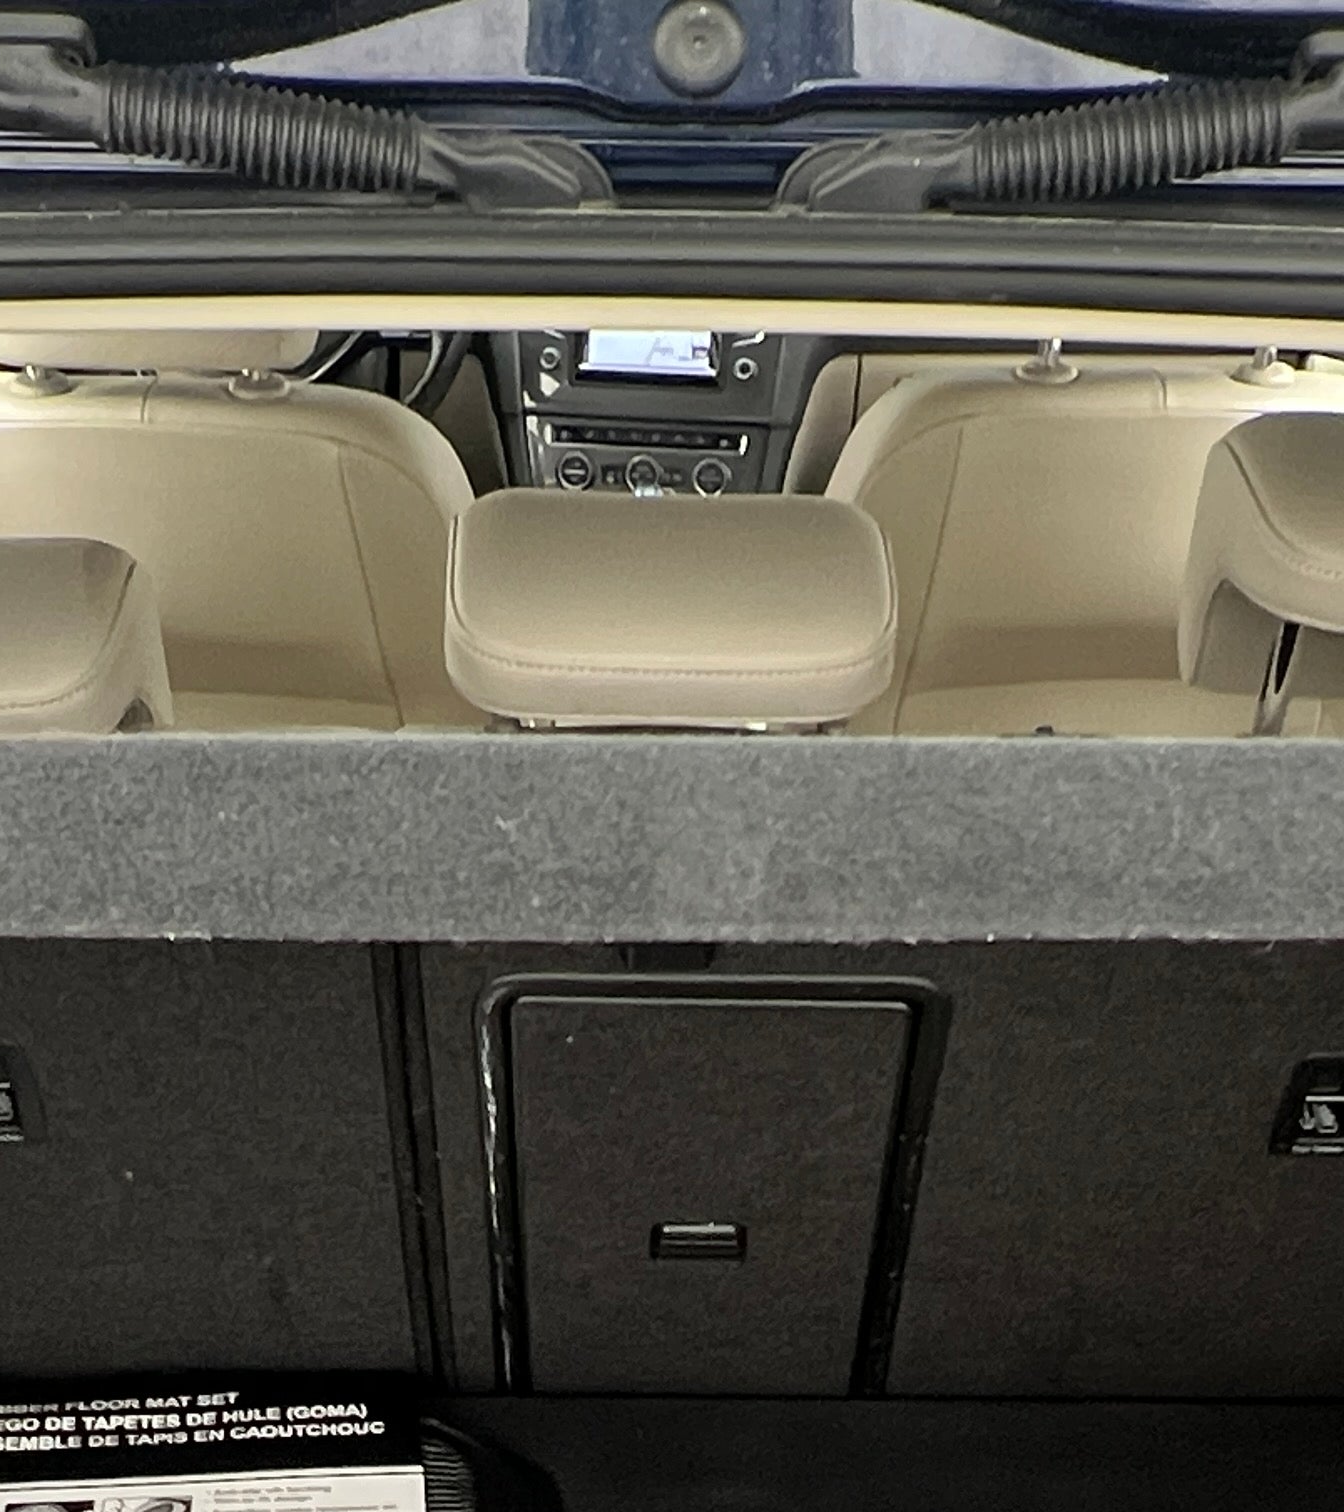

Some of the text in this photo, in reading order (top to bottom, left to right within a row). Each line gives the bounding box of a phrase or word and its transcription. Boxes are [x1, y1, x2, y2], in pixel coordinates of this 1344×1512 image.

[65, 1398, 141, 1411] FLOOR
[145, 1395, 193, 1409] MAT
[196, 1391, 240, 1406] SET
[44, 1416, 77, 1432] DE
[81, 1413, 181, 1432] TAPETES
[186, 1411, 218, 1427] DE
[222, 1407, 282, 1424] HULE
[286, 1403, 368, 1422] (GOMA)
[88, 1434, 120, 1448] DE
[124, 1431, 188, 1446] TAPIS
[193, 1428, 225, 1443] EN
[230, 1421, 386, 1440] CAOUTCHOUC
